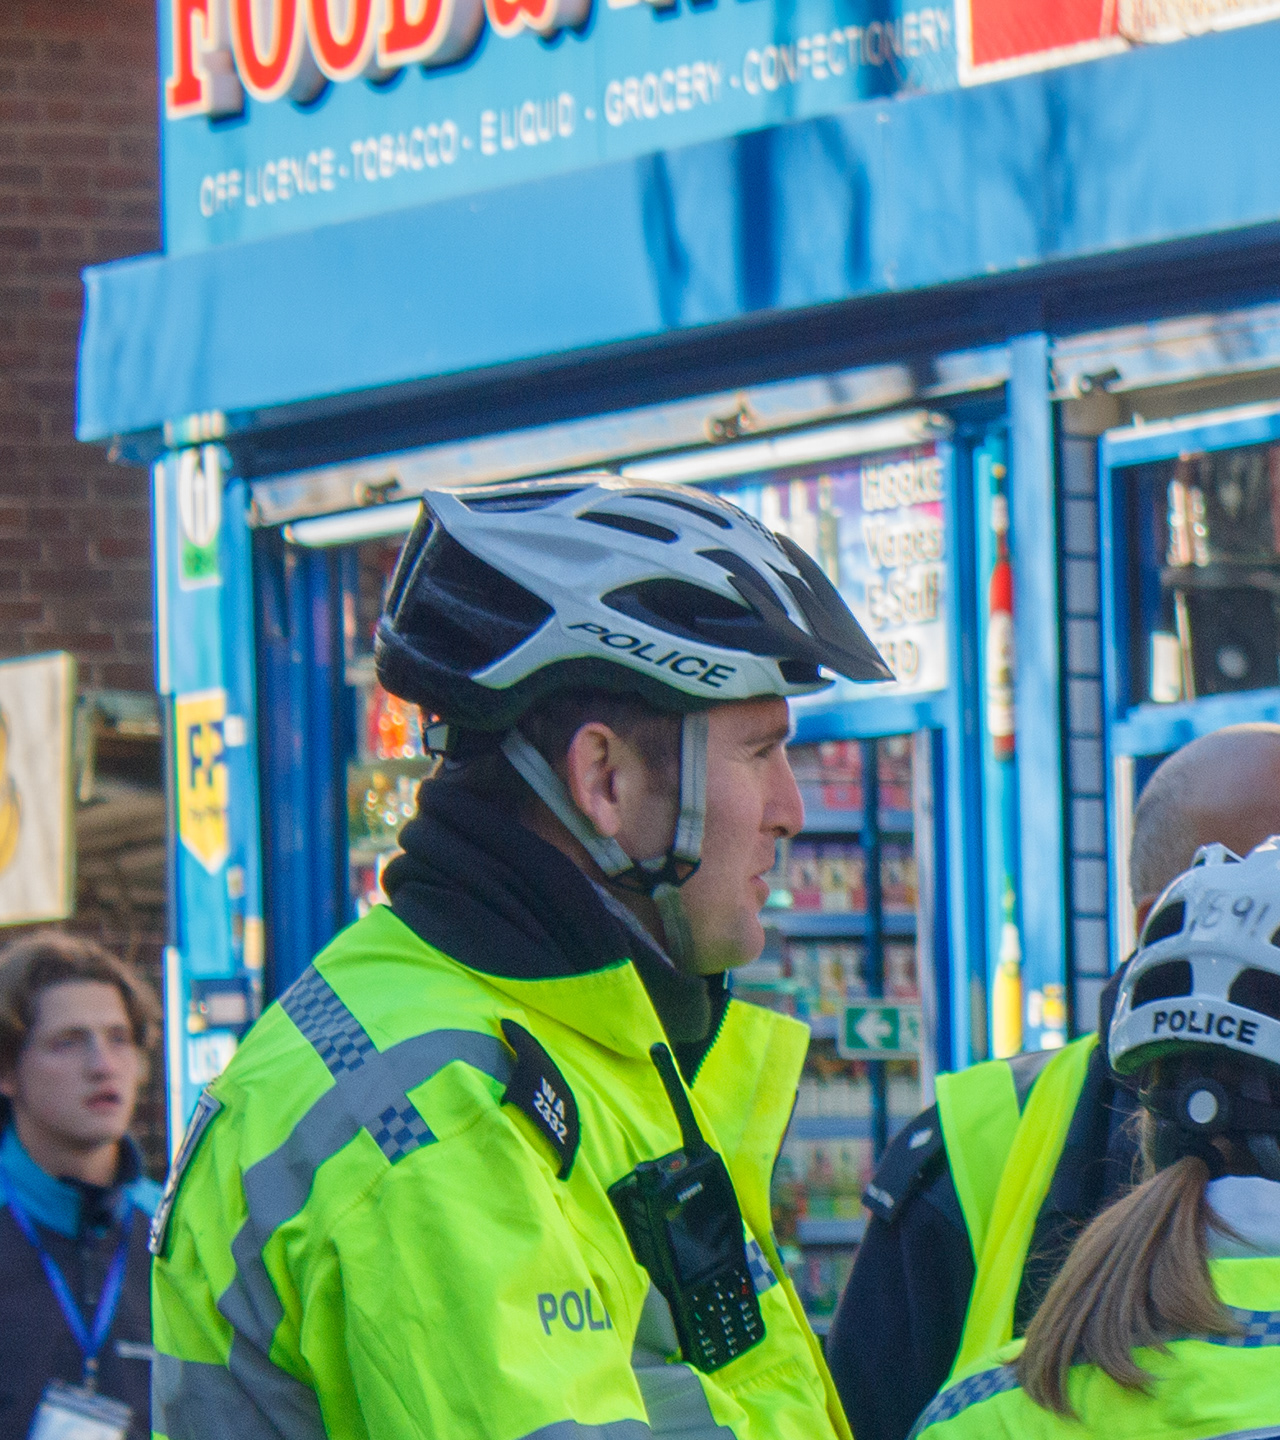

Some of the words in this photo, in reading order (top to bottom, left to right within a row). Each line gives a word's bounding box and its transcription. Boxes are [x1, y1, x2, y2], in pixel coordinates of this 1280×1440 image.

[200, 169, 242, 218] OFF
[244, 147, 336, 208] LICENCE
[350, 119, 458, 183] TOBACCO
[500, 91, 575, 151] LIQUID
[604, 60, 723, 128] GROCERY
[742, 8, 955, 96] CONFECTIONERY
[566, 621, 738, 689] POLICE
[1152, 1009, 1259, 1047] POLICE
[532, 1089, 569, 1145] 2332
[539, 1075, 566, 1121] WA
